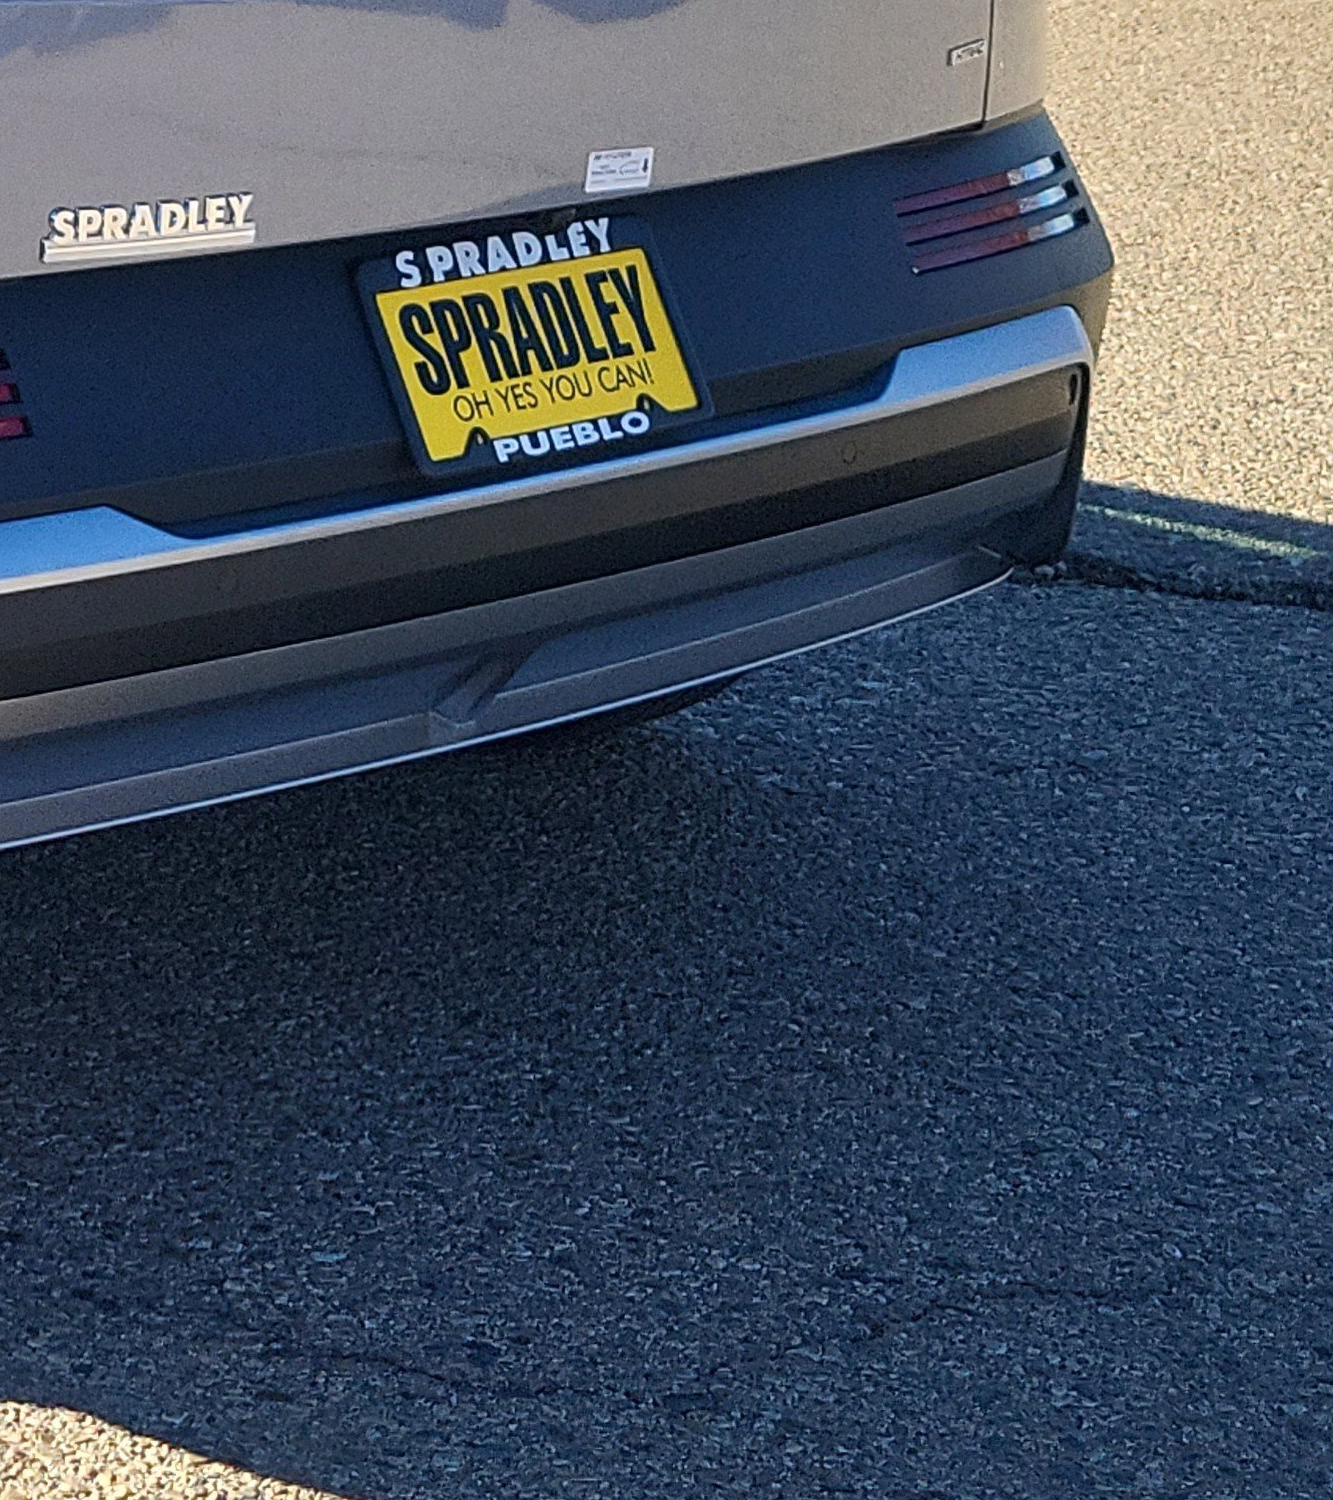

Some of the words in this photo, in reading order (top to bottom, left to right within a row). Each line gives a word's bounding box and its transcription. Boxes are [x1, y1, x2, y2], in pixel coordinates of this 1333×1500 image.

[48, 192, 253, 245] SPRADLEY
[399, 264, 656, 395] SPRADLEY
[453, 388, 494, 422] OH
[495, 382, 538, 413] YES
[539, 369, 593, 405] YOU
[597, 358, 655, 392] CAN!
[493, 410, 650, 463] PUEBLO
